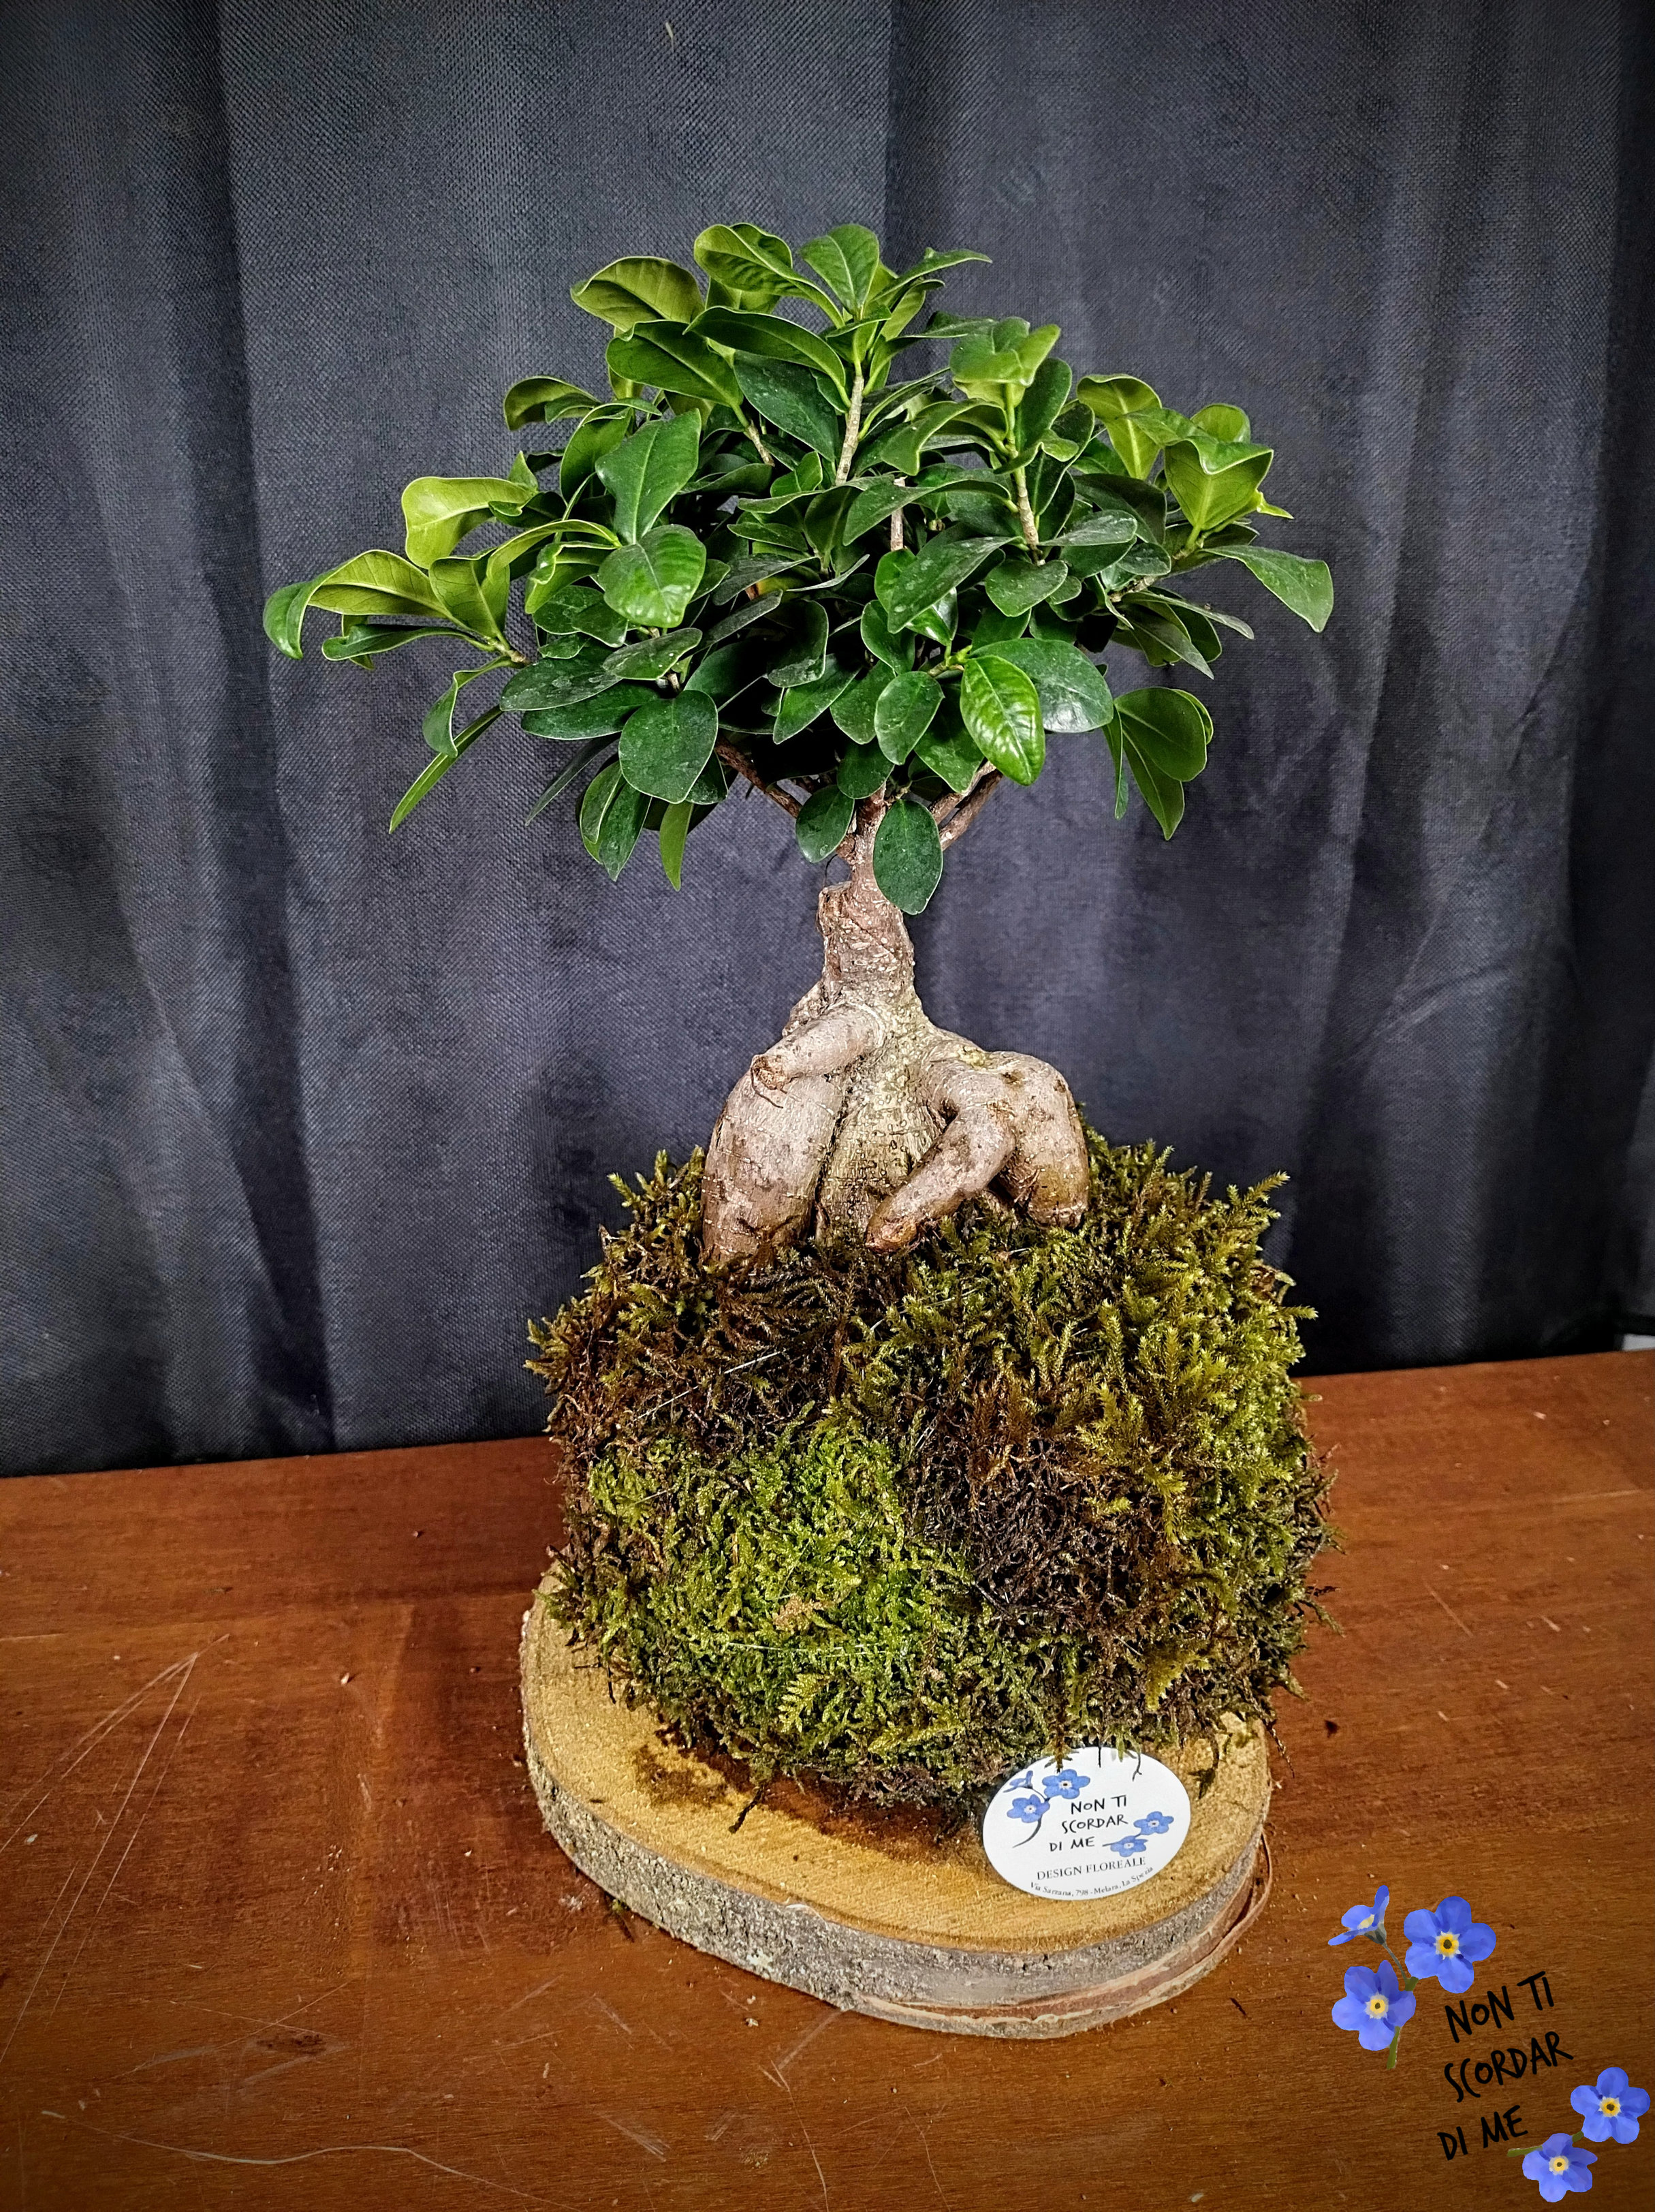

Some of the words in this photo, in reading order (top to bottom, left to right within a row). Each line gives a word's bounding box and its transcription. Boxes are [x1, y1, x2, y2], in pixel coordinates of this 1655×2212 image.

[1071, 1798, 1105, 1815] NON
[1111, 1794, 1126, 1807] TI
[1062, 1814, 1129, 1834] SCORDAR
[1050, 1842, 1062, 1852] DI
[1071, 1837, 1094, 1850] ME
[1030, 1882, 1041, 1891] Via
[1131, 1867, 1154, 1882] Spezia
[1037, 1866, 1082, 1880] DESIGN
[1086, 1857, 1146, 1874] FLOREALE
